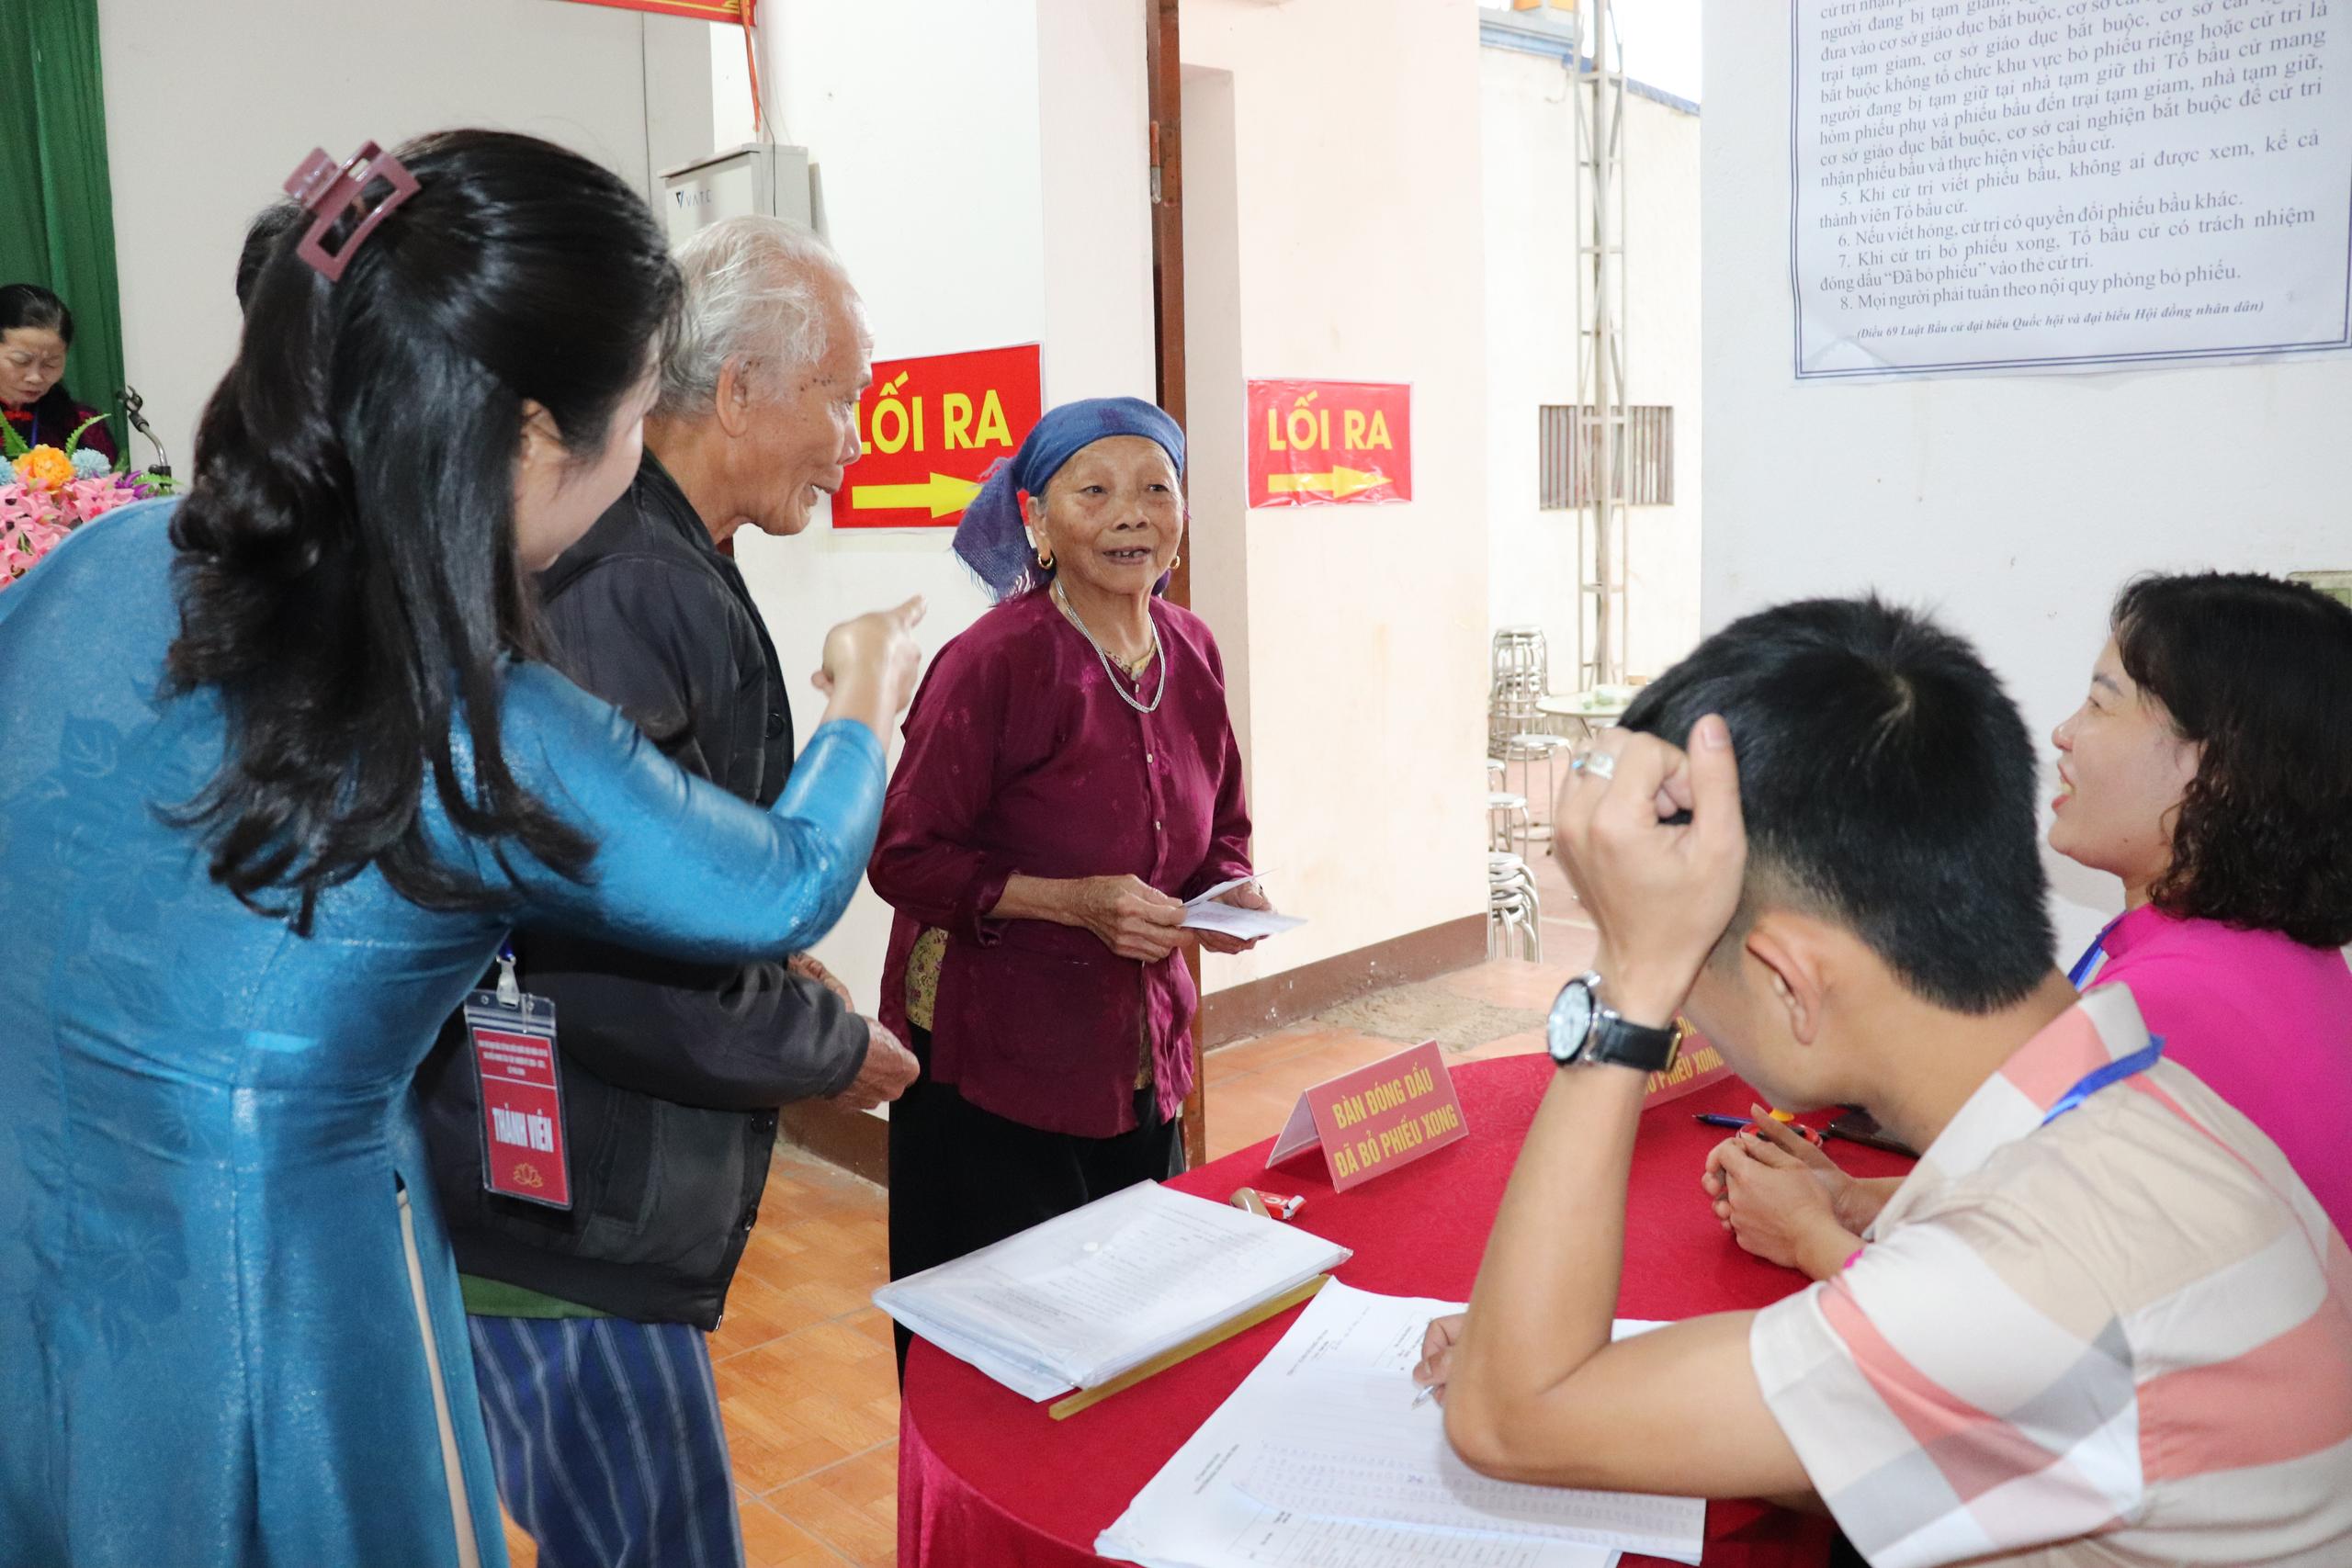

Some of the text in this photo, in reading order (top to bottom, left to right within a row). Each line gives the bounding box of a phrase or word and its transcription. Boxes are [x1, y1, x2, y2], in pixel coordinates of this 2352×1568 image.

[1820, 105, 1860, 126] người
[1866, 102, 1900, 120] đang
[1908, 96, 1920, 112] bị
[1929, 94, 1955, 109] tạm
[1963, 85, 1987, 106] giữ
[1996, 85, 2013, 98] tại
[2022, 74, 2050, 92] nhà
[2058, 73, 2087, 89] tạm
[2098, 63, 2124, 85] giữ
[2133, 57, 2154, 74] thì
[2198, 41, 2229, 63] bầu
[2238, 40, 2260, 57] cử
[2270, 31, 2324, 51] mang
[1821, 88, 1840, 103] bắt
[1847, 81, 1879, 99] buộc
[1885, 73, 1929, 94] không
[1954, 64, 1990, 81] chức
[1997, 58, 2025, 73] khu
[2032, 54, 2061, 70] vực
[2068, 48, 2087, 62] bỏ
[2094, 36, 2141, 62] phiếu
[2148, 28, 2192, 50] riêng
[2200, 19, 2242, 43] hoặc
[2250, 13, 2273, 29] cử
[2280, 9, 2301, 23] tri
[2310, 0, 2326, 17] là
[1820, 130, 1849, 144] hòm
[1855, 117, 1893, 143] phiếu
[1899, 118, 1925, 137] phụ
[1932, 113, 1948, 128] và
[1954, 103, 1996, 129] phiếu
[2003, 100, 2030, 118] bầu
[2036, 95, 2064, 112] đến
[2072, 94, 2098, 108] trại
[2106, 87, 2137, 105] tạm
[2202, 68, 2234, 88] nhà
[2243, 64, 2276, 84] tạm
[1820, 154, 1837, 165] cơ
[1842, 151, 1857, 163] sở
[1863, 144, 1893, 164] giáo
[1898, 141, 1924, 160] dục
[1931, 130, 1951, 150] bắt
[2007, 128, 2026, 140] cơ
[2032, 122, 2051, 136] sở
[2056, 115, 2079, 132] cai
[2087, 107, 2144, 130] nghiện
[2153, 97, 2177, 118] bắt
[2187, 95, 2231, 115] buộc
[2268, 85, 2292, 101] cử
[2301, 77, 2321, 96] tri
[1821, 170, 1854, 187] nhận
[1856, 161, 1894, 186] phiếu
[1898, 157, 1924, 176] bầu
[1928, 157, 1944, 172] và
[1948, 155, 1981, 172] thực
[1984, 149, 2017, 167] hiện
[2021, 143, 2052, 162] việc
[2058, 135, 2086, 155] bầu
[1839, 191, 1852, 205] 5.
[1860, 187, 1883, 203] Khi
[1892, 186, 1909, 198] cử
[1917, 185, 1932, 196] tri
[1941, 175, 1967, 191] viết
[1976, 167, 2018, 193] phiếu
[2070, 159, 2120, 177] không
[2130, 157, 2143, 169] ai
[2154, 150, 2199, 167] được
[2297, 134, 2318, 147] cả
[1819, 211, 1856, 228] thành
[1860, 209, 1889, 222] viên
[1915, 198, 1941, 217] bầu
[1838, 235, 1850, 246] 6.
[1855, 226, 1883, 244] Nếu
[1887, 225, 1913, 241] viết
[1961, 220, 1980, 234] cử
[1983, 216, 1999, 231] tri
[2003, 214, 2021, 230] có
[2025, 206, 2074, 231] quyền
[2108, 196, 2154, 223] phiếu
[2159, 195, 2189, 213] bầu
[2195, 193, 2243, 209] khác.
[1838, 254, 1850, 267] 7.
[1859, 250, 1883, 265] Khi
[1890, 250, 1907, 263] cử
[1916, 245, 1929, 260] tri
[1939, 244, 1957, 258] bỏ
[1965, 235, 2007, 261] phiếu
[2100, 222, 2128, 243] bầu
[2138, 225, 2159, 239] cử
[2168, 220, 2188, 236] có
[2199, 214, 2243, 232] trách
[2255, 210, 2313, 228] nhiệm
[1819, 256, 2093, 292] đóng dấu bỏ vào thẻ cử tri.
[1840, 264, 2241, 310] 8. Mọi người phải tuân theo nội quy phòng bỏ phiếu.
[1885, 326, 1898, 335] 69
[1900, 324, 1924, 336] Luật
[1966, 321, 1983, 333] đại
[2045, 315, 2063, 327] hội
[2067, 314, 2079, 323] và
[2083, 311, 2101, 325] đại
[2134, 308, 2157, 321] Hội
[2196, 303, 2229, 315] nhân
[2233, 301, 2263, 313] dân)
[943, 389, 1013, 450] RA
[1268, 389, 1393, 451] LỐI RA
[1331, 1061, 1434, 1130] BÀN ĐÓNG DẤU
[492, 1102, 555, 1154] THÀNH VIÊN
[1333, 1103, 1460, 1179] ĐÃ BỎ PHIẾU XONG
